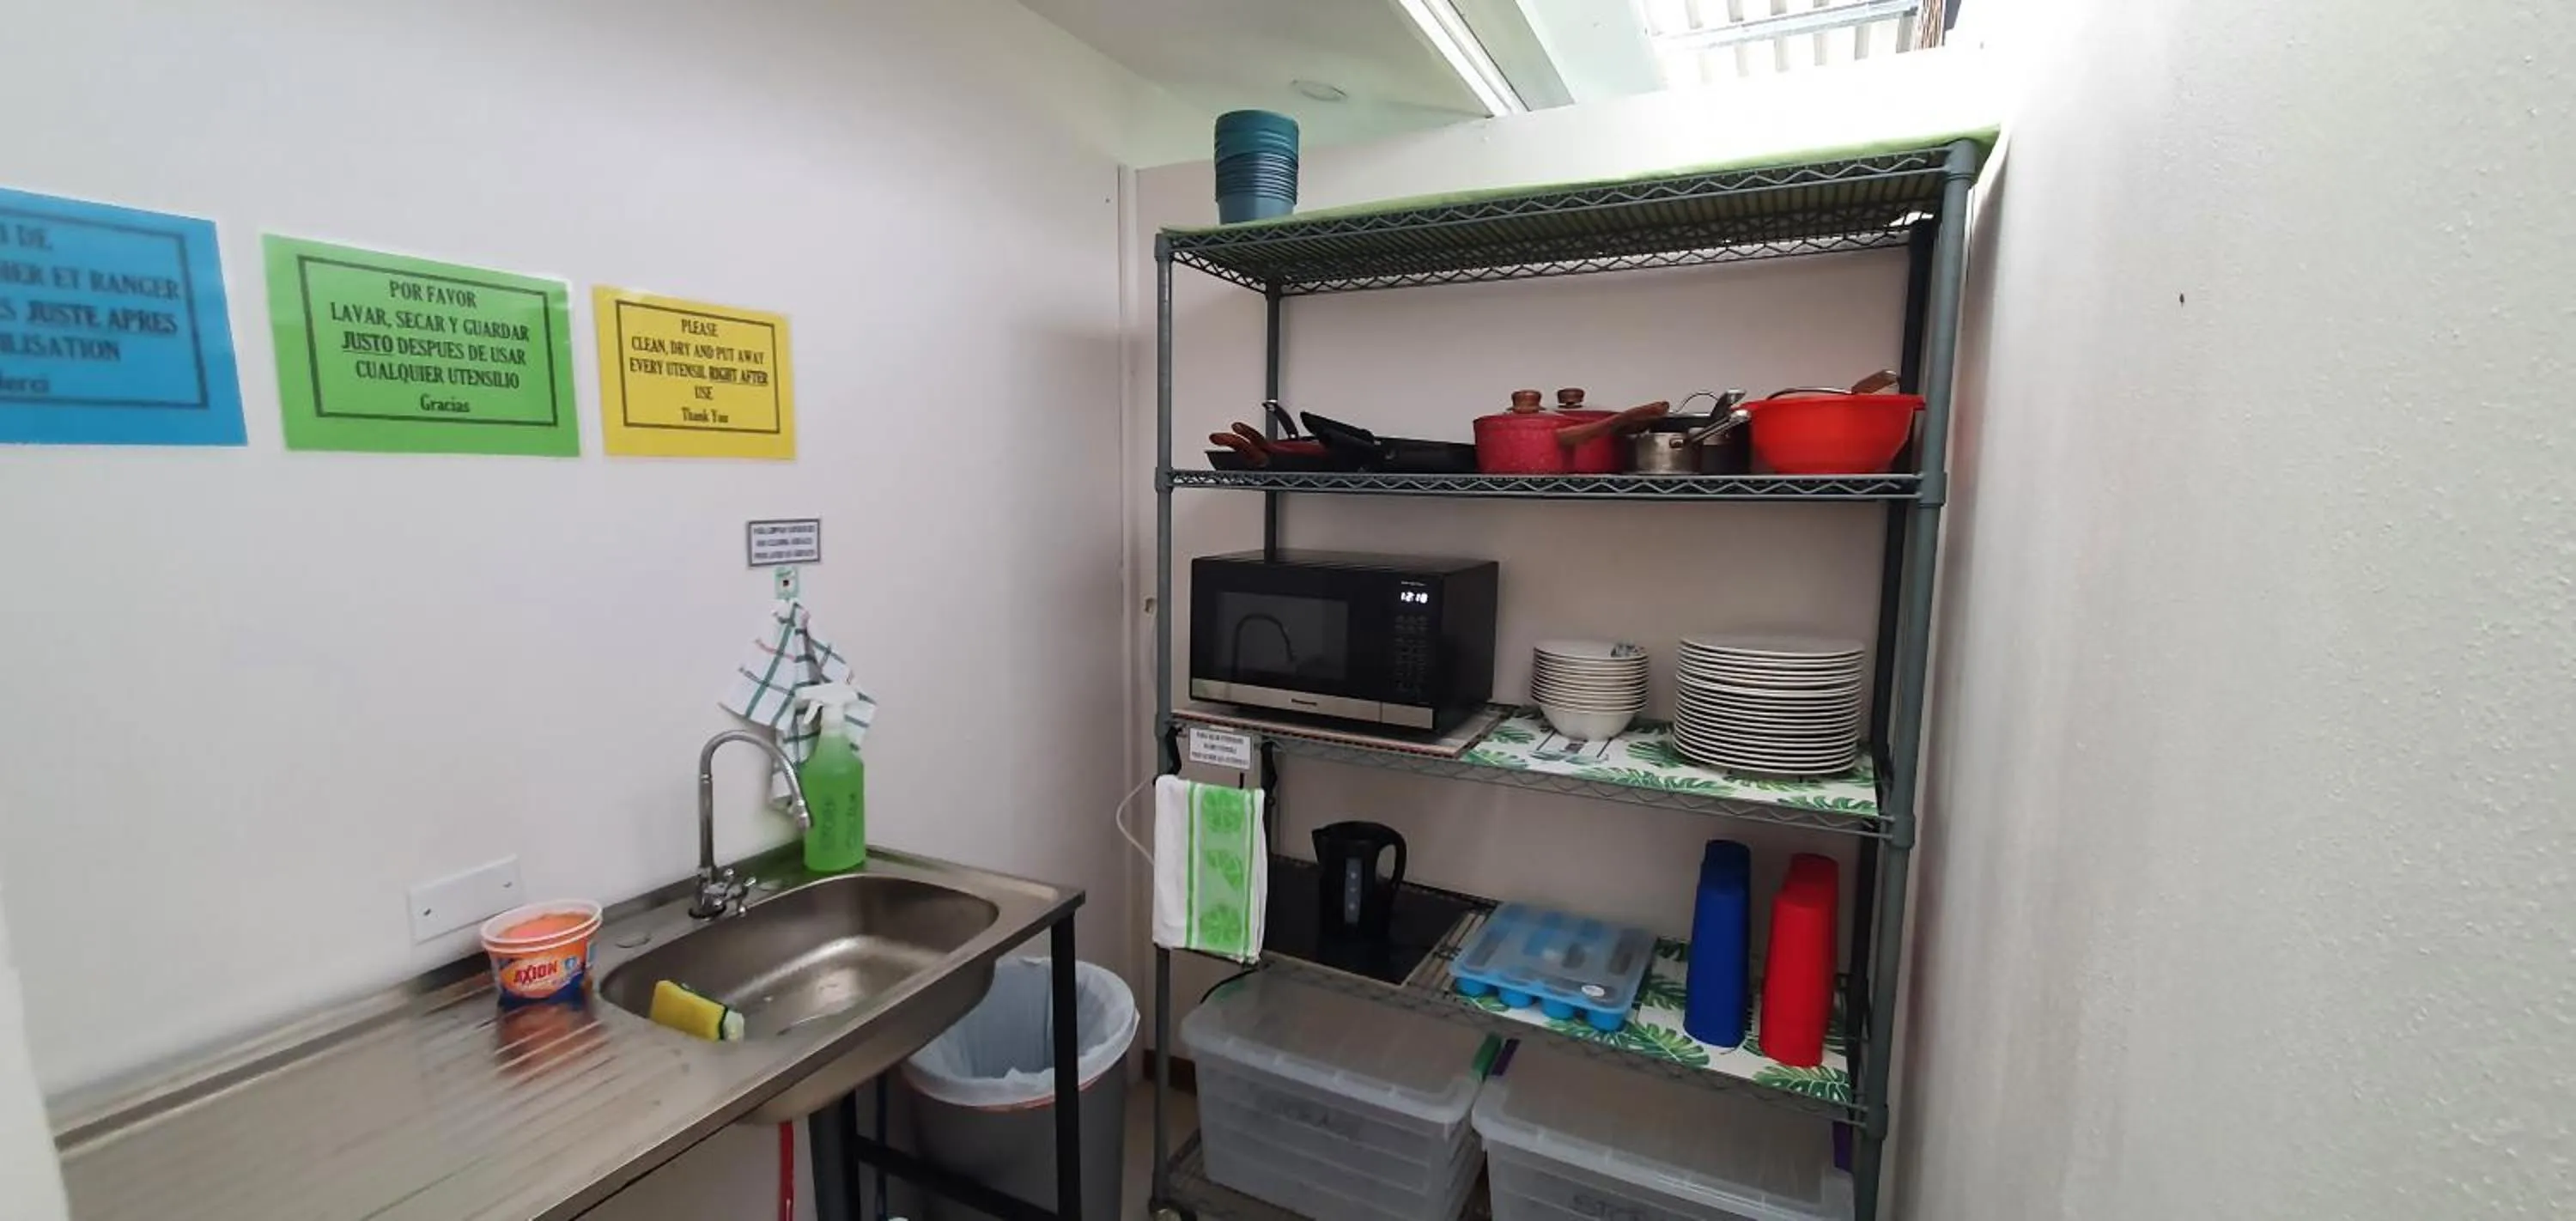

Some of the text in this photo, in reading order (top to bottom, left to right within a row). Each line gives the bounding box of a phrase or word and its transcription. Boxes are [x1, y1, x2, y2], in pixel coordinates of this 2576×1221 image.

[88, 269, 179, 301] RANGER
[388, 280, 477, 309] POR FAVOR
[26, 301, 100, 328] JUSTE
[106, 309, 178, 335] APRES
[330, 302, 530, 342] LAVAR, SECAR Y GUARDAR
[681, 319, 719, 337] PLEASE
[342, 331, 527, 366] JUSTO DESPUES DE USAR
[631, 336, 765, 365] CLEAN, DRY AND PUT AWAY
[355, 361, 520, 390] CUALQUIER UTENSILIO
[629, 357, 769, 386] EVERY UTENSIL RIGHT AFTER
[419, 394, 471, 413] Gracias
[694, 386, 714, 400] USE
[681, 406, 730, 424] Thank You
[514, 961, 558, 984] AXION
